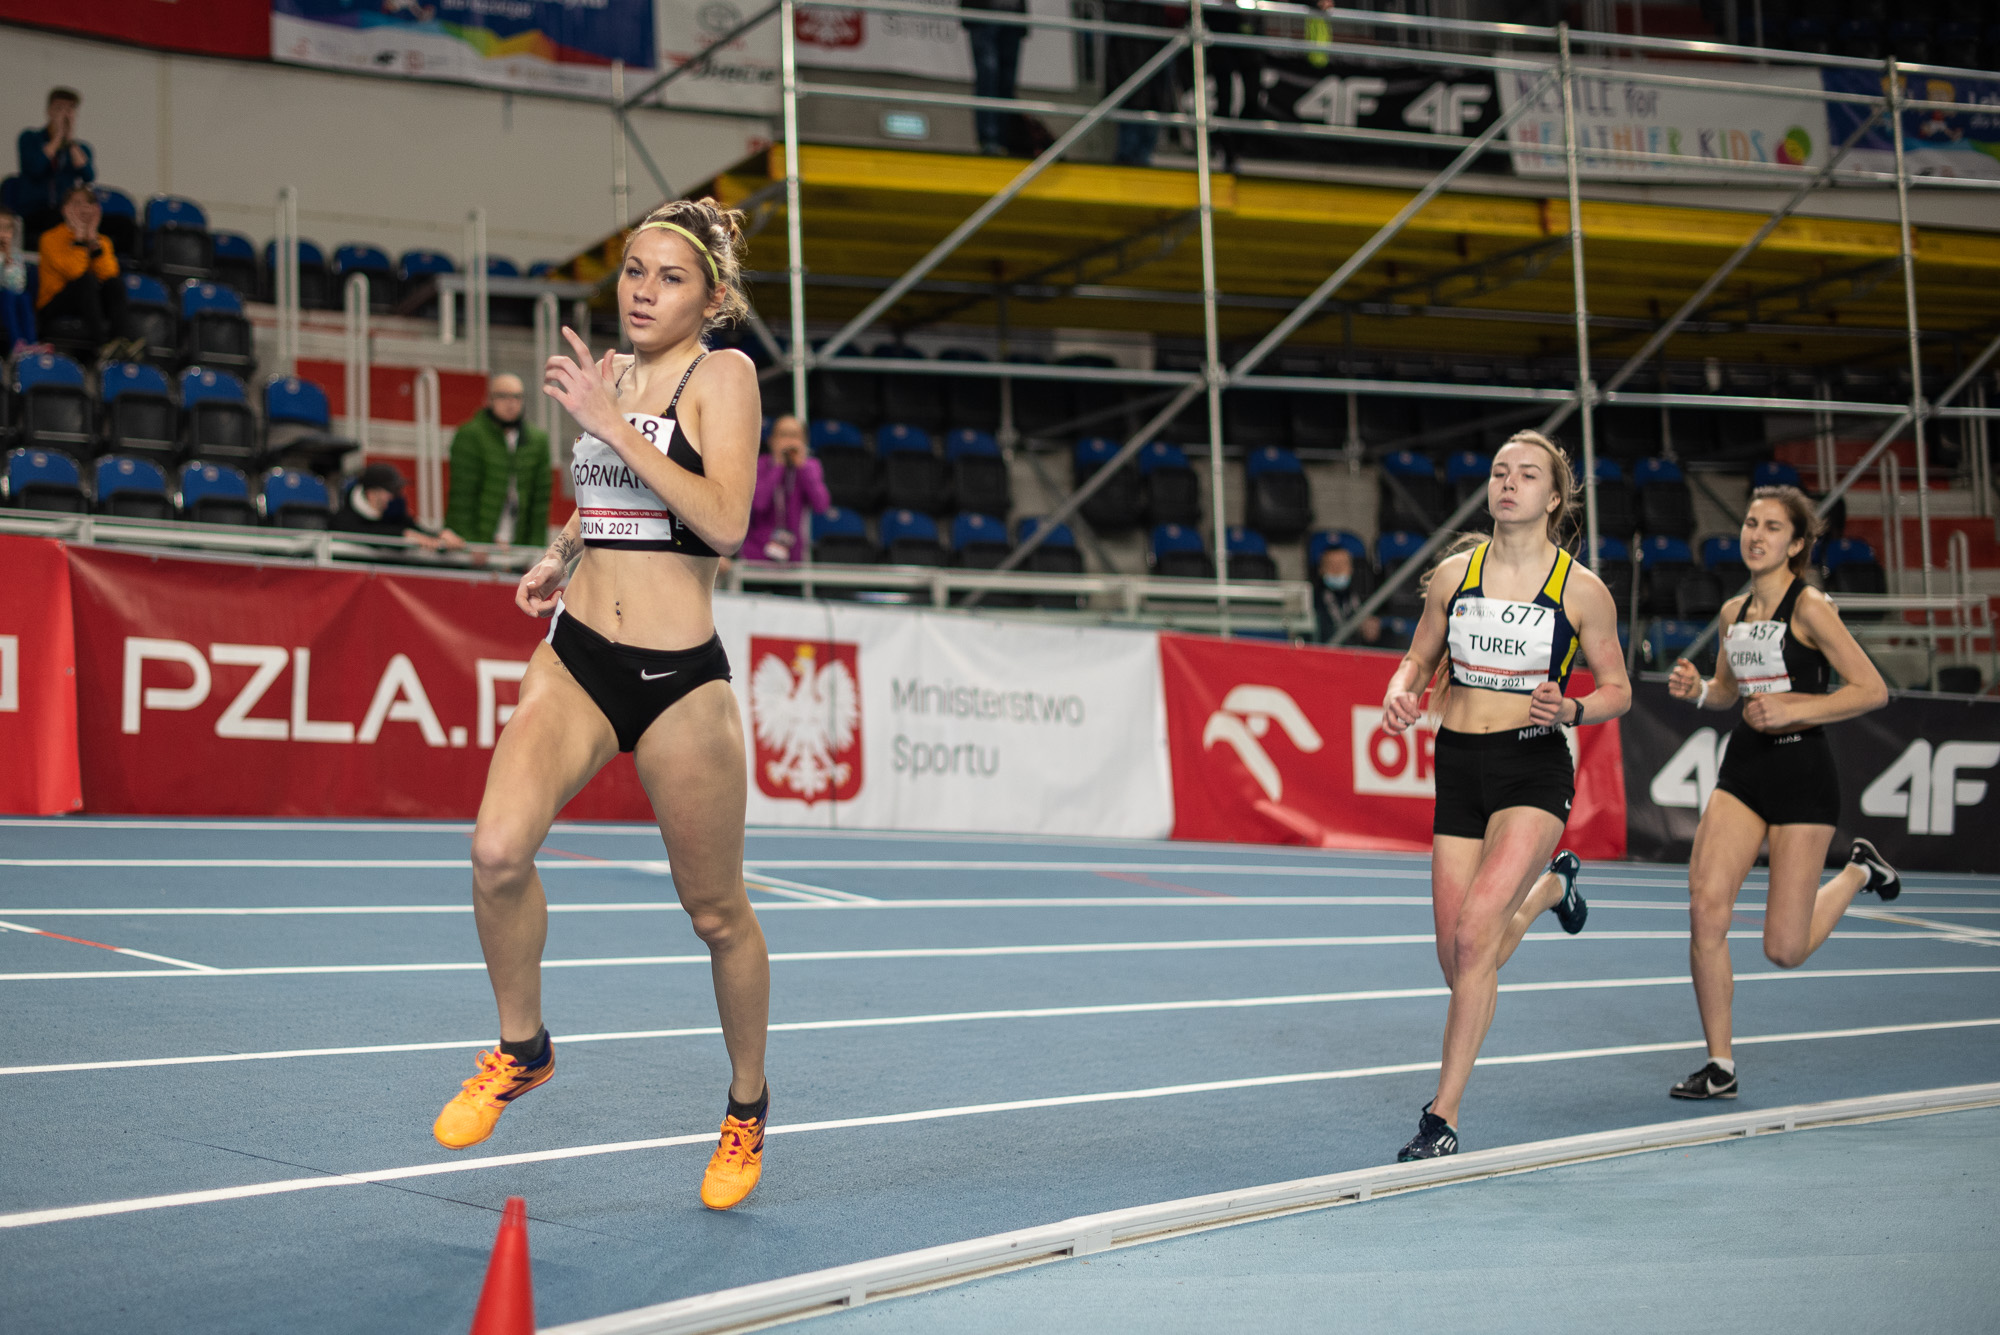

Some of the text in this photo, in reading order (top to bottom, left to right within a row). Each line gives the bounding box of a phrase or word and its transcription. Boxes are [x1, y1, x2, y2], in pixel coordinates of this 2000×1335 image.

[1294, 74, 1388, 128] 4F
[1402, 81, 1492, 135] 4F
[608, 522, 639, 535] 2021
[1501, 604, 1546, 627] 677
[1749, 623, 1779, 641] 457
[1469, 633, 1527, 657] TUREK
[1501, 676, 1526, 688] 2021
[890, 677, 1085, 727] Ministerstwo
[891, 734, 999, 781] Sportu
[1860, 738, 2000, 836] 4F
